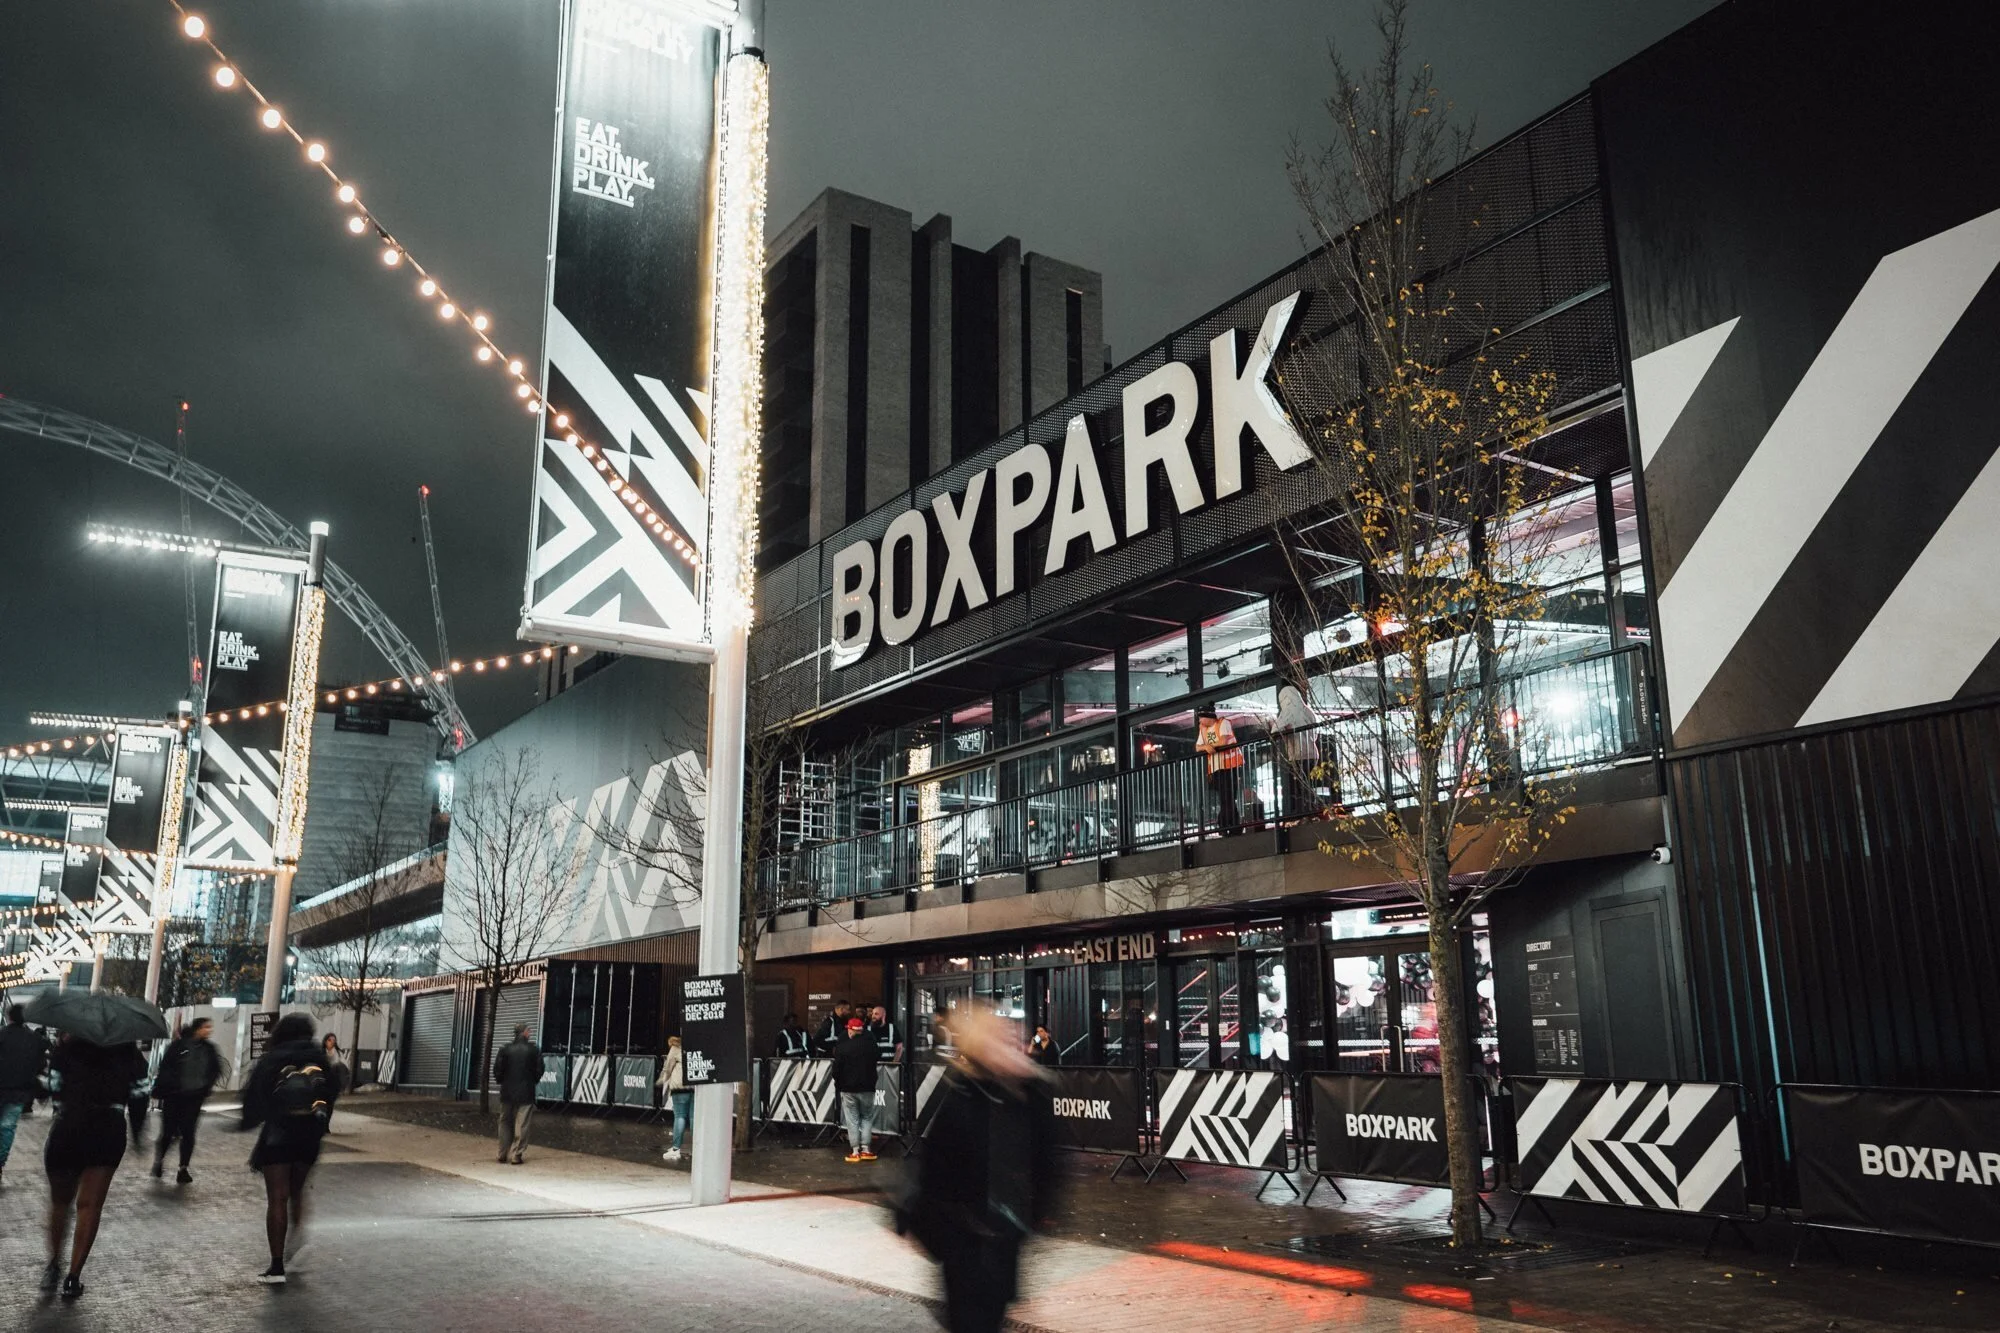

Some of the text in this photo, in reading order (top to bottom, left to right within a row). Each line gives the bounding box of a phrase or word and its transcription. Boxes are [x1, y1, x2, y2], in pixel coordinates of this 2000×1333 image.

[576, 117, 621, 149] EAT.
[574, 141, 655, 186] DRINK.
[573, 167, 634, 203] PLAY.
[831, 290, 1313, 671] BOXPARK
[219, 631, 243, 644] EAT.
[218, 643, 259, 659] DRINK.
[217, 655, 248, 669] PLAY.
[1074, 931, 1155, 964] EAST END
[684, 979, 722, 990] BOXPARK
[685, 987, 725, 998] WEMBLEY
[685, 1002, 726, 1012] KICKS OFF
[685, 1010, 724, 1021] DEC 2018
[687, 1051, 703, 1060] EAT.
[687, 1060, 715, 1069] DRINK.
[687, 1069, 709, 1080] PLAY.
[623, 1075, 646, 1088] BOXPARK
[1053, 1097, 1112, 1120] BOXPARK
[1345, 1113, 1438, 1142] BOXPARK
